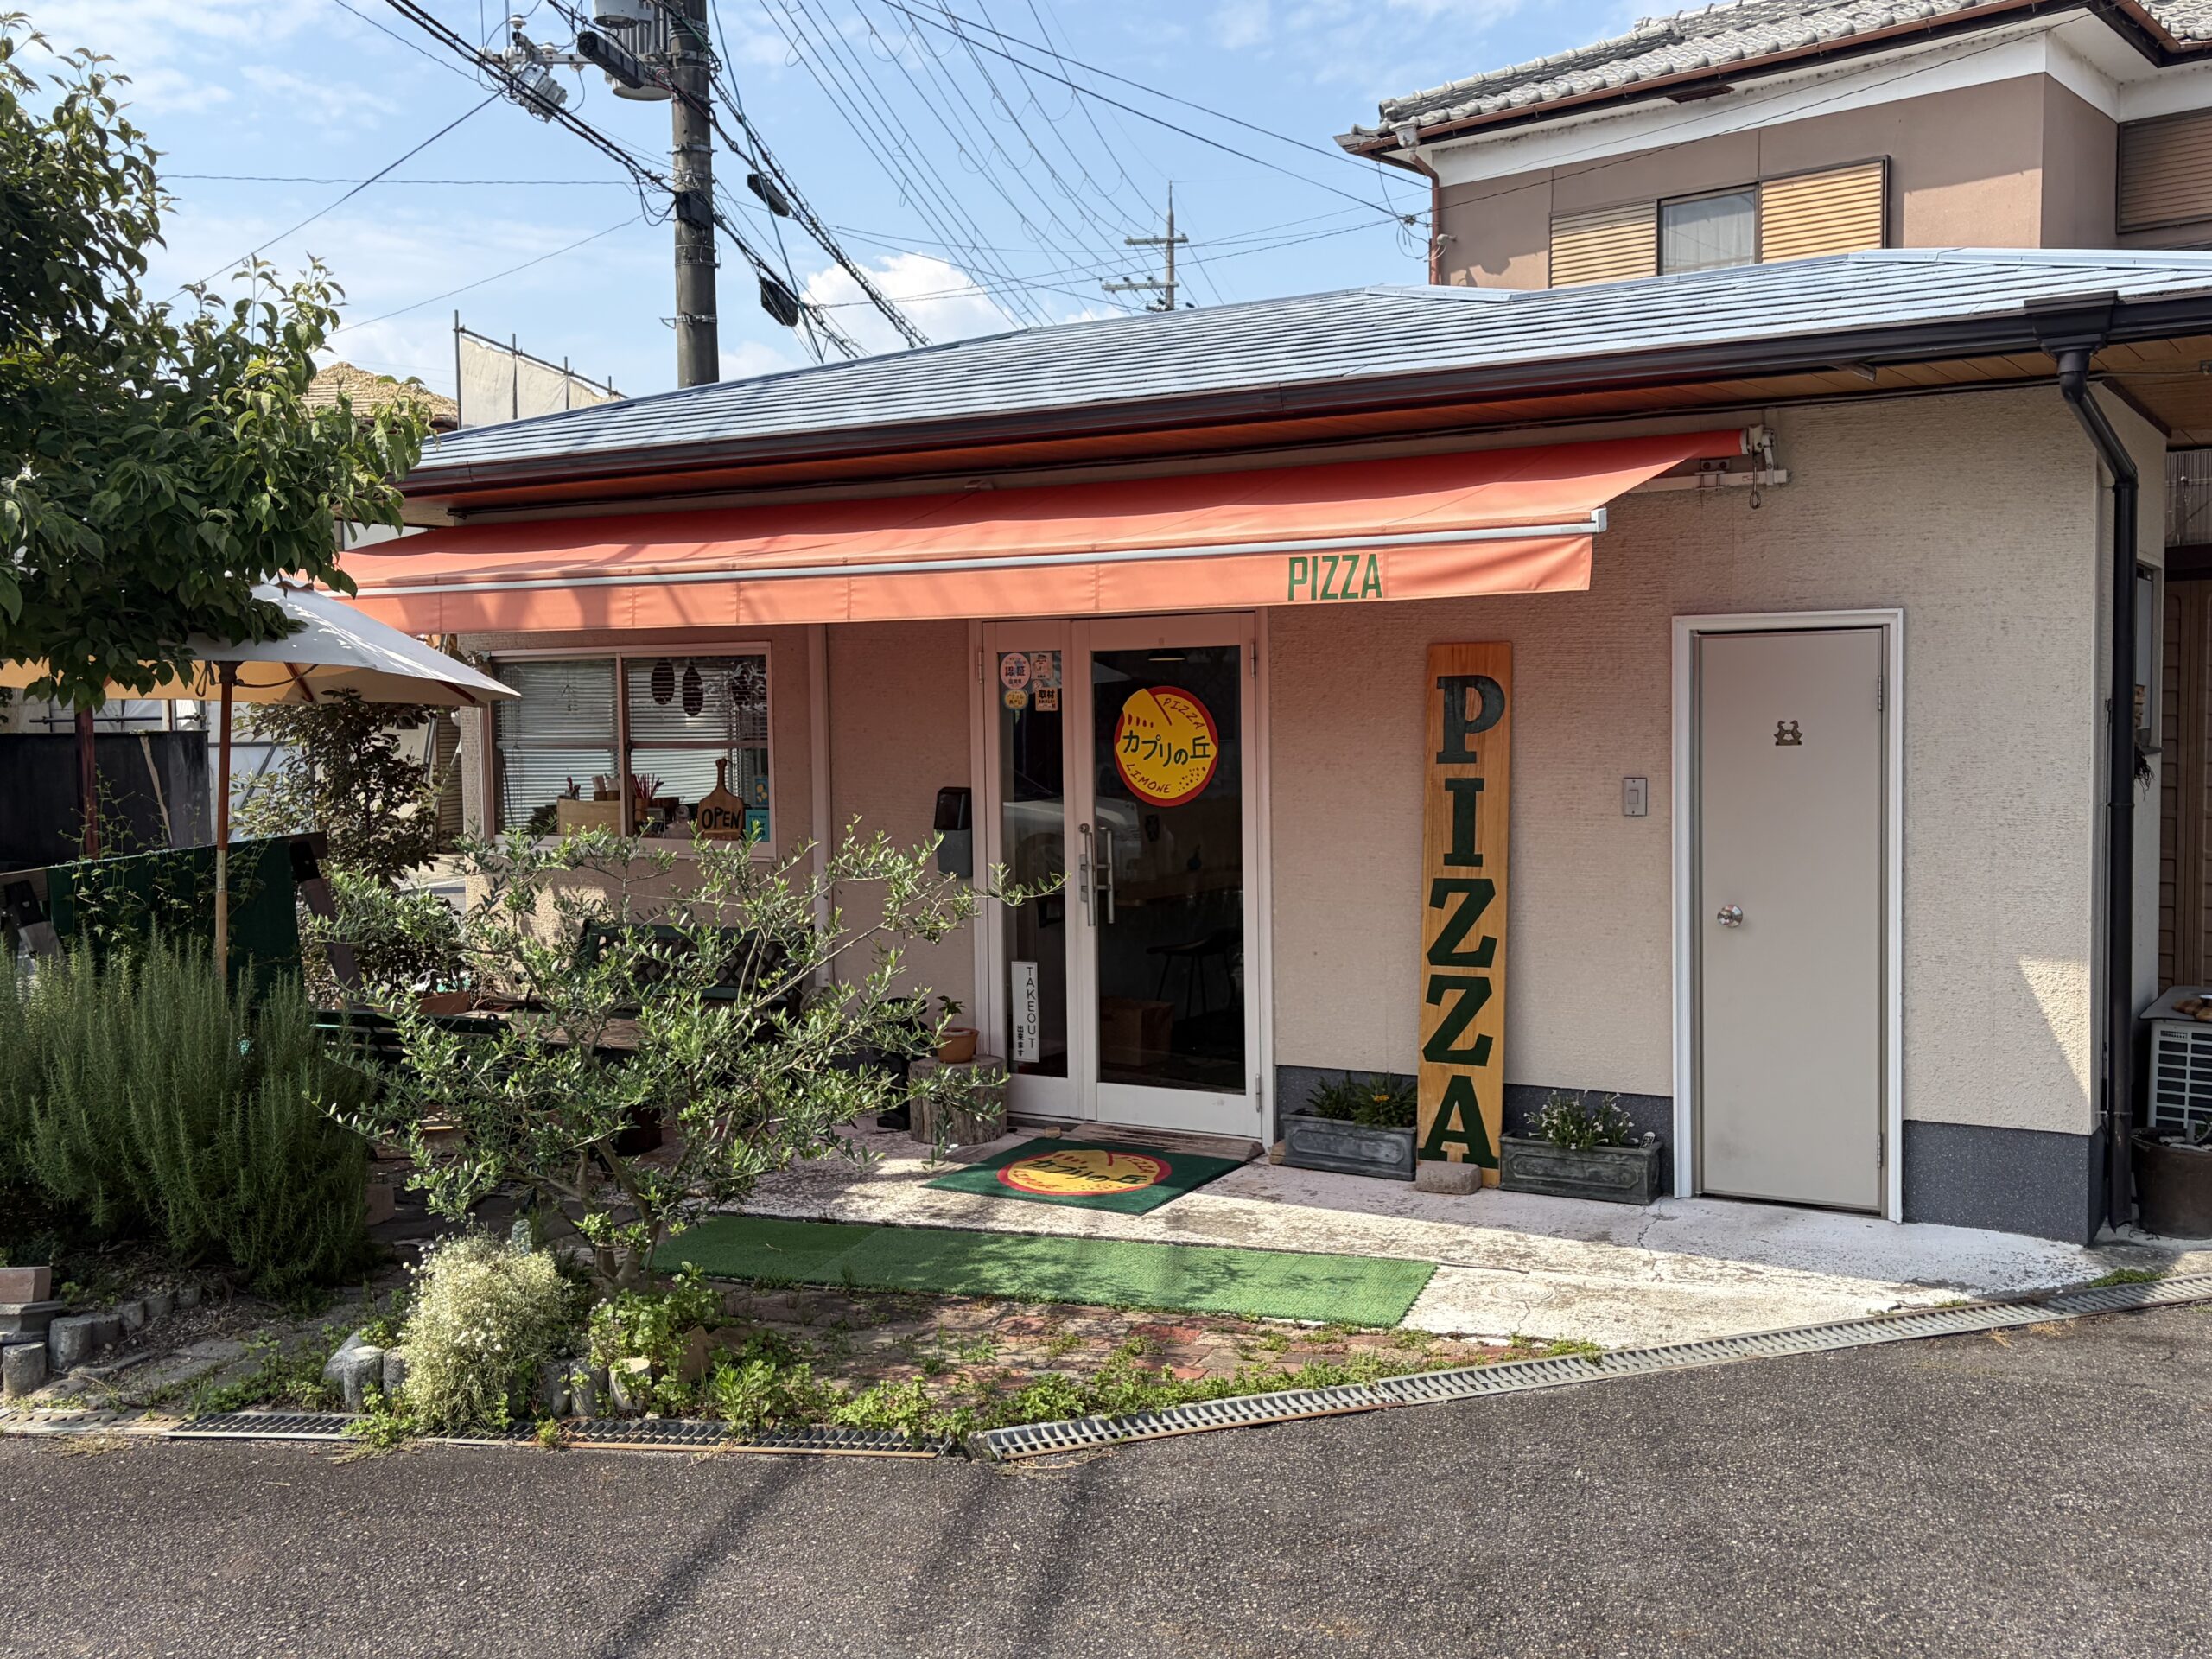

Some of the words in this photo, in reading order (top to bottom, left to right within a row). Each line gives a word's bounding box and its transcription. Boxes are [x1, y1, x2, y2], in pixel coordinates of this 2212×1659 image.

[1287, 554, 1382, 601] PIZZA
[1039, 689, 1054, 699] 取材
[1163, 697, 1205, 730] PIZZA
[1122, 730, 1211, 767] カプリの丘
[1126, 763, 1171, 793] LIMONE
[702, 807, 741, 830] OPEN
[1418, 675, 1505, 1169] PIZZA
[1026, 966, 1036, 1049] TAKEOUT
[1023, 1160, 1148, 1185] カプリの丘
